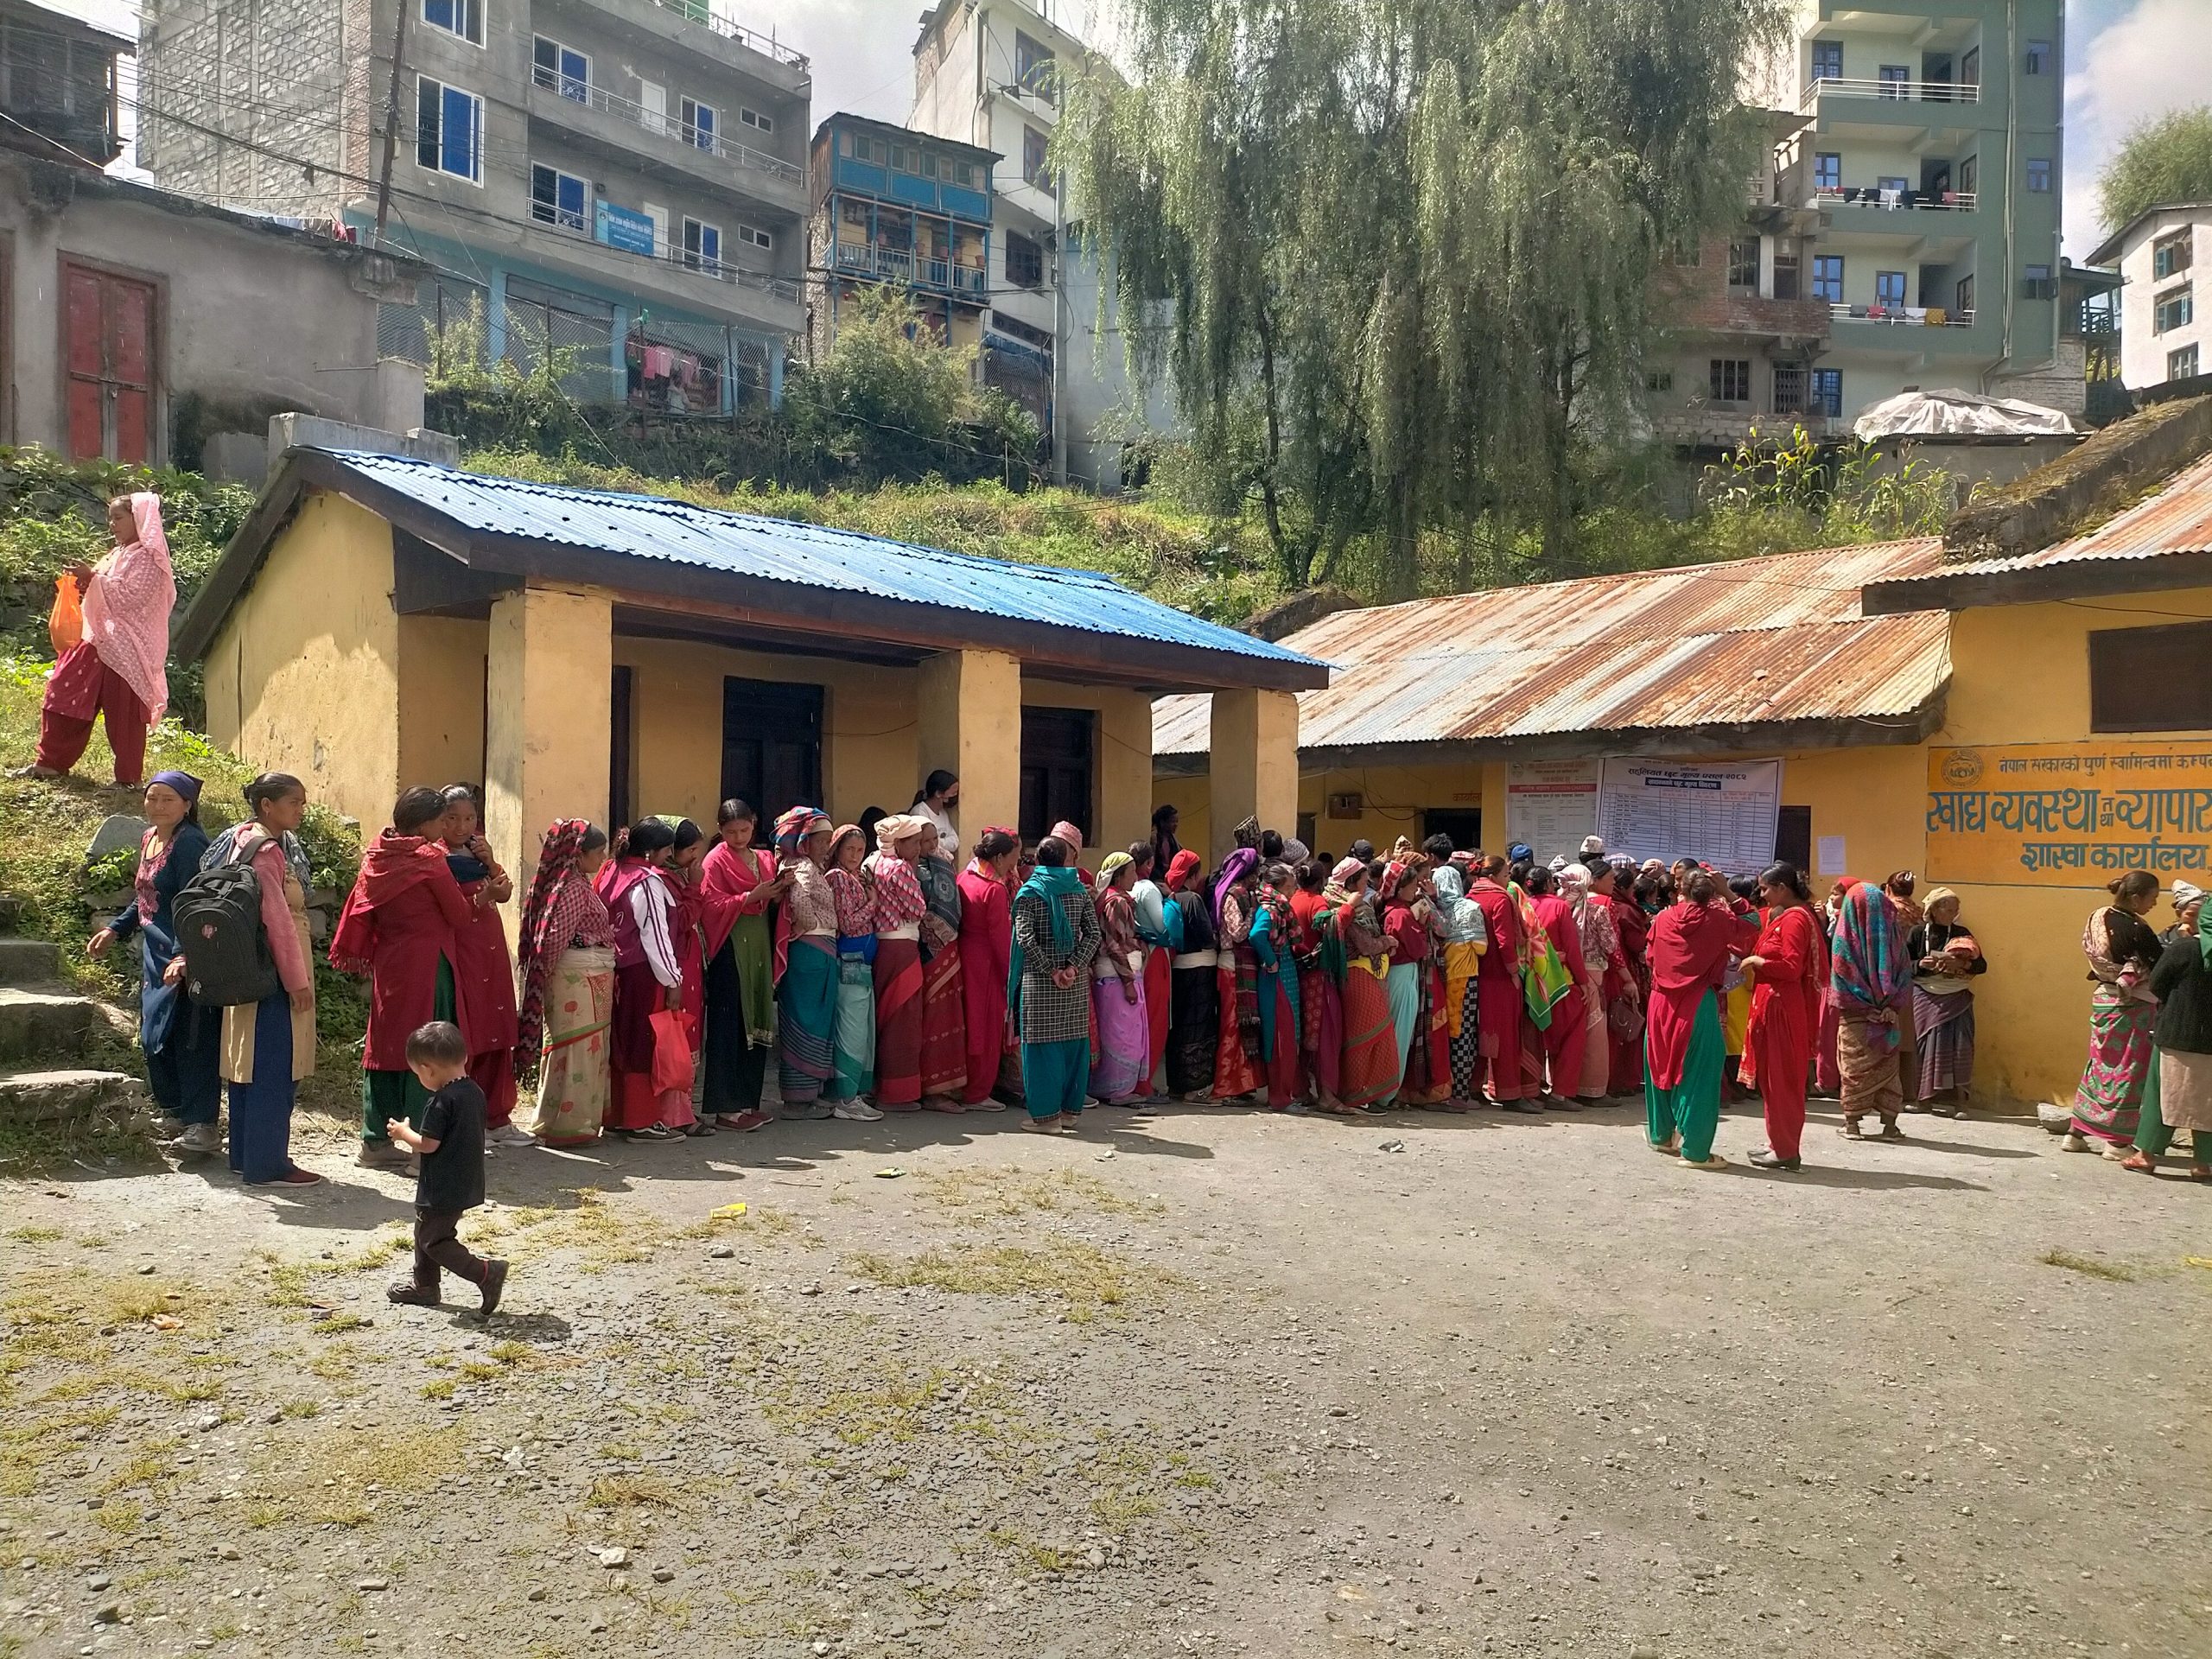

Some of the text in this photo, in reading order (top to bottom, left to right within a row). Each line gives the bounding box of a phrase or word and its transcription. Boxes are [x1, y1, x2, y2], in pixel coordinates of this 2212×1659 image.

[2031, 754, 2081, 772] सरकारको
[1452, 791, 1482, 802] कार्याल
[1926, 791, 1990, 833] खाद्य
[1991, 787, 2101, 833] व्यवस्था
[2115, 789, 2212, 833] व्यापार
[2020, 842, 2089, 872] शाखा
